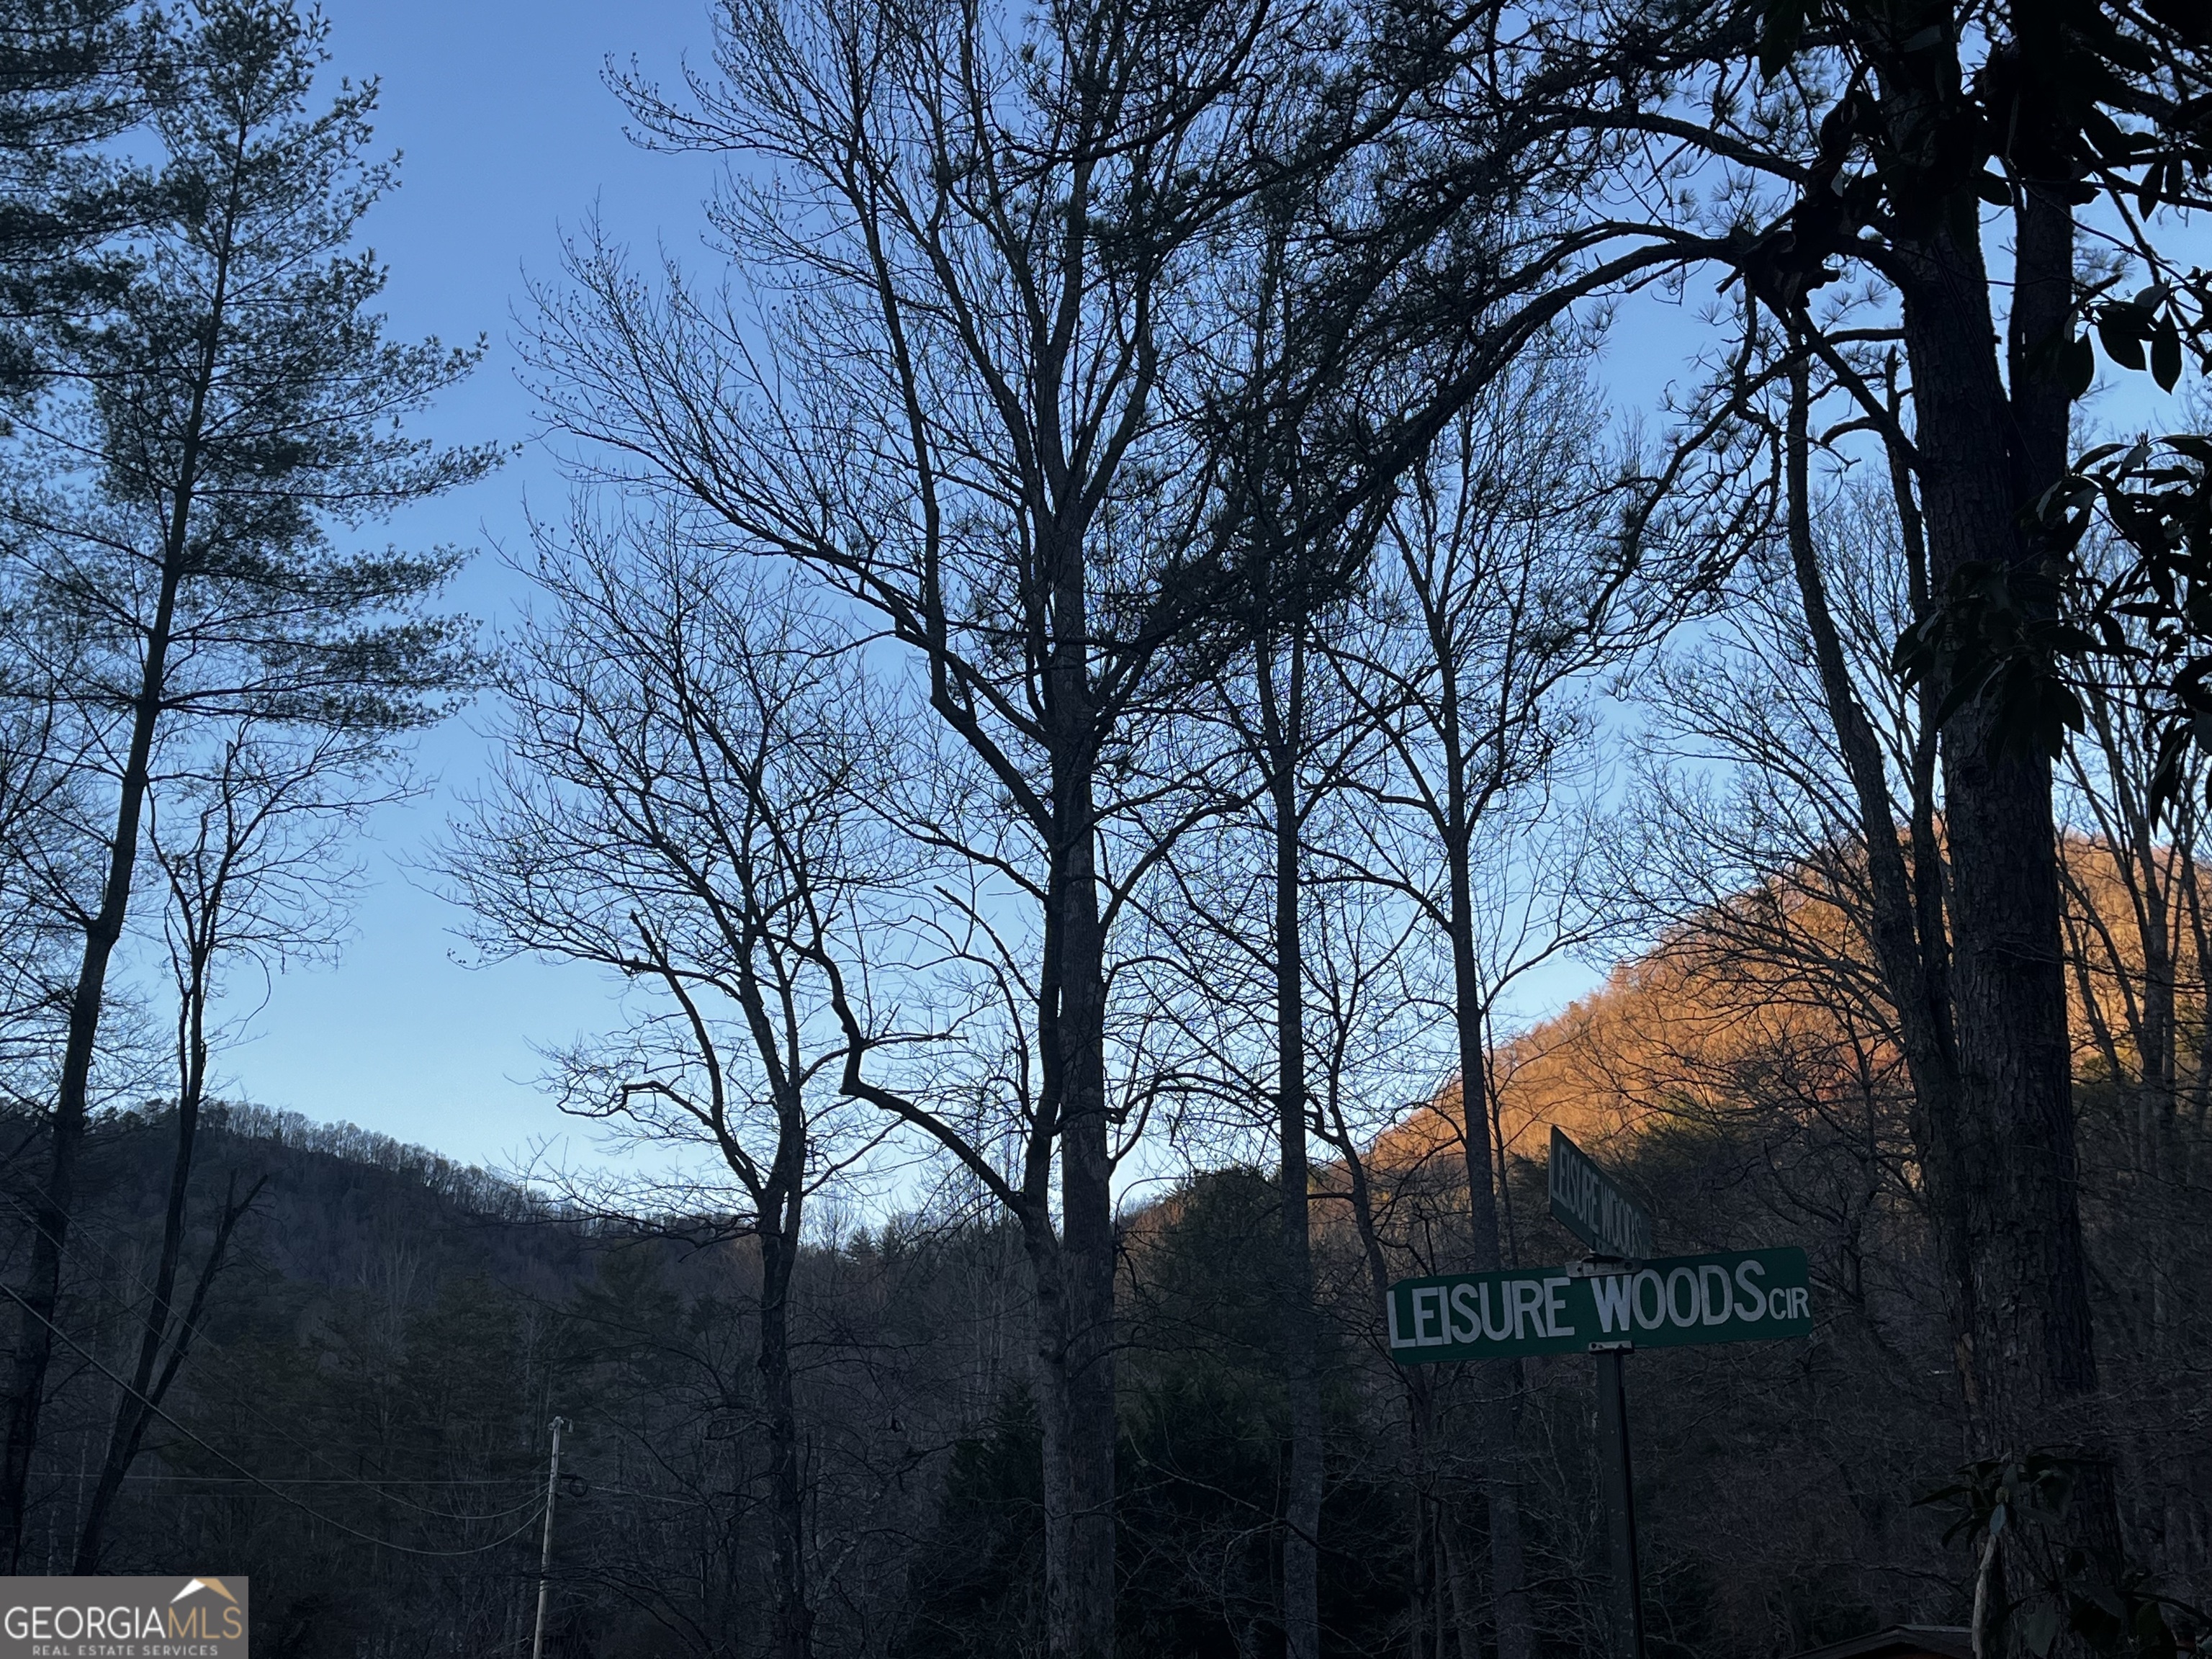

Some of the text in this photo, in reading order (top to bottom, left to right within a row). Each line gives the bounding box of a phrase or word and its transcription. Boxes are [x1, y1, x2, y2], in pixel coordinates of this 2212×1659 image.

[1551, 1136, 1643, 1258] LEISURE WOODS
[1387, 1260, 1810, 1349] LEISURE WOODS CIR
